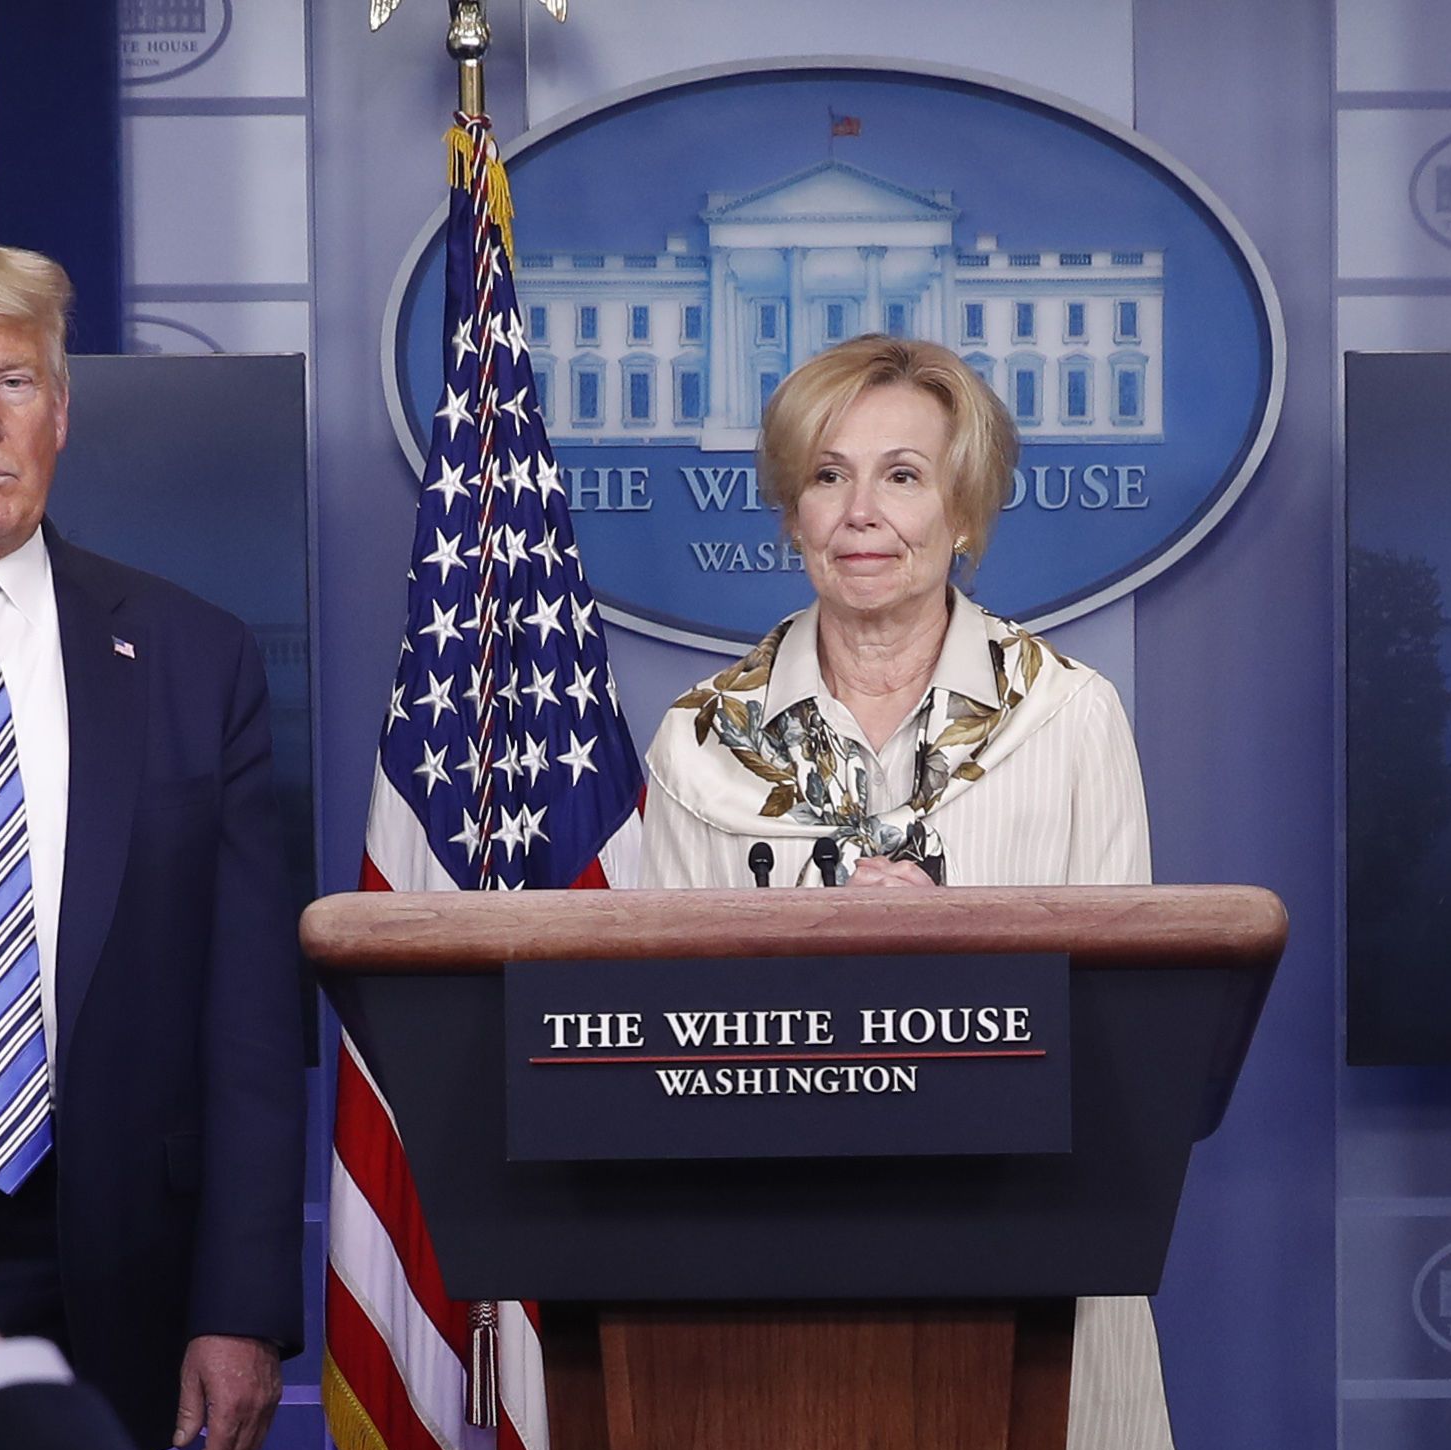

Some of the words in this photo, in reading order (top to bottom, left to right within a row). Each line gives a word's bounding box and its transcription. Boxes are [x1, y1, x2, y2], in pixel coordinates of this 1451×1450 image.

[148, 41, 198, 52] HOUSE
[560, 467, 652, 511] HE
[543, 1012, 645, 1049] THE
[663, 1010, 834, 1047] WHITE
[859, 1007, 1031, 1044] HOUSE
[655, 1065, 918, 1096] WASHINGTON
